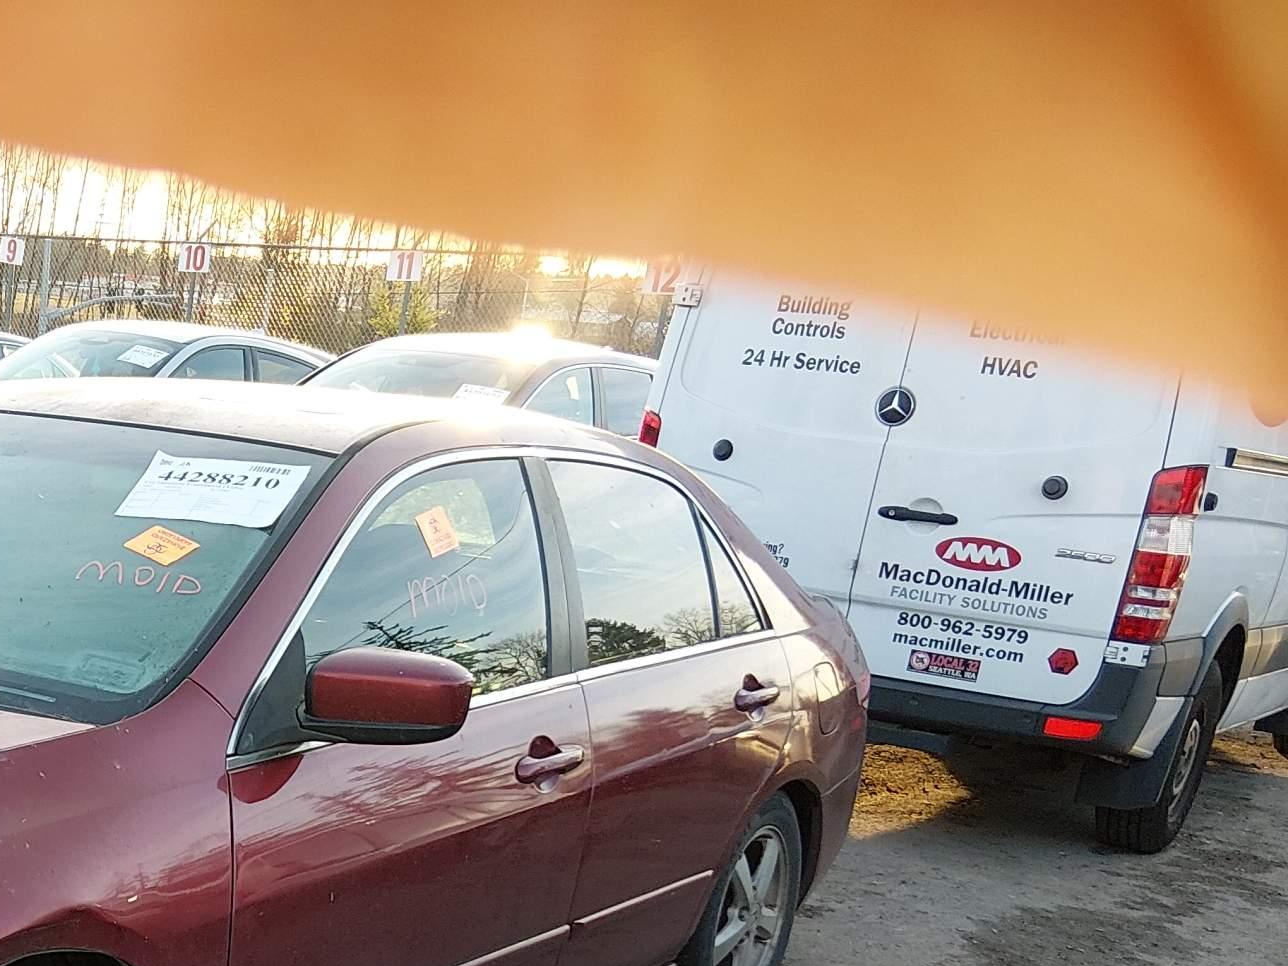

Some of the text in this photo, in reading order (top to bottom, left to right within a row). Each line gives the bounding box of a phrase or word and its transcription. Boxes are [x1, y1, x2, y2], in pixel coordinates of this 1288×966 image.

[6, 239, 17, 263] 9
[185, 244, 206, 271] 10
[397, 251, 415, 280] 11
[651, 258, 681, 293] 12
[777, 294, 852, 321] Building
[772, 317, 846, 340] Controls
[742, 348, 861, 375] 24 Hr Service
[980, 356, 1039, 379] HVAC
[158, 470, 280, 490] 44288210
[878, 561, 1074, 606] MacDonald-Miller
[890, 585, 1049, 620] FACILITY SOLUTIONS
[897, 611, 1029, 645] 800-962-5979
[892, 631, 1024, 663] macmiller.com
[930, 654, 980, 673] LOCAL 32
